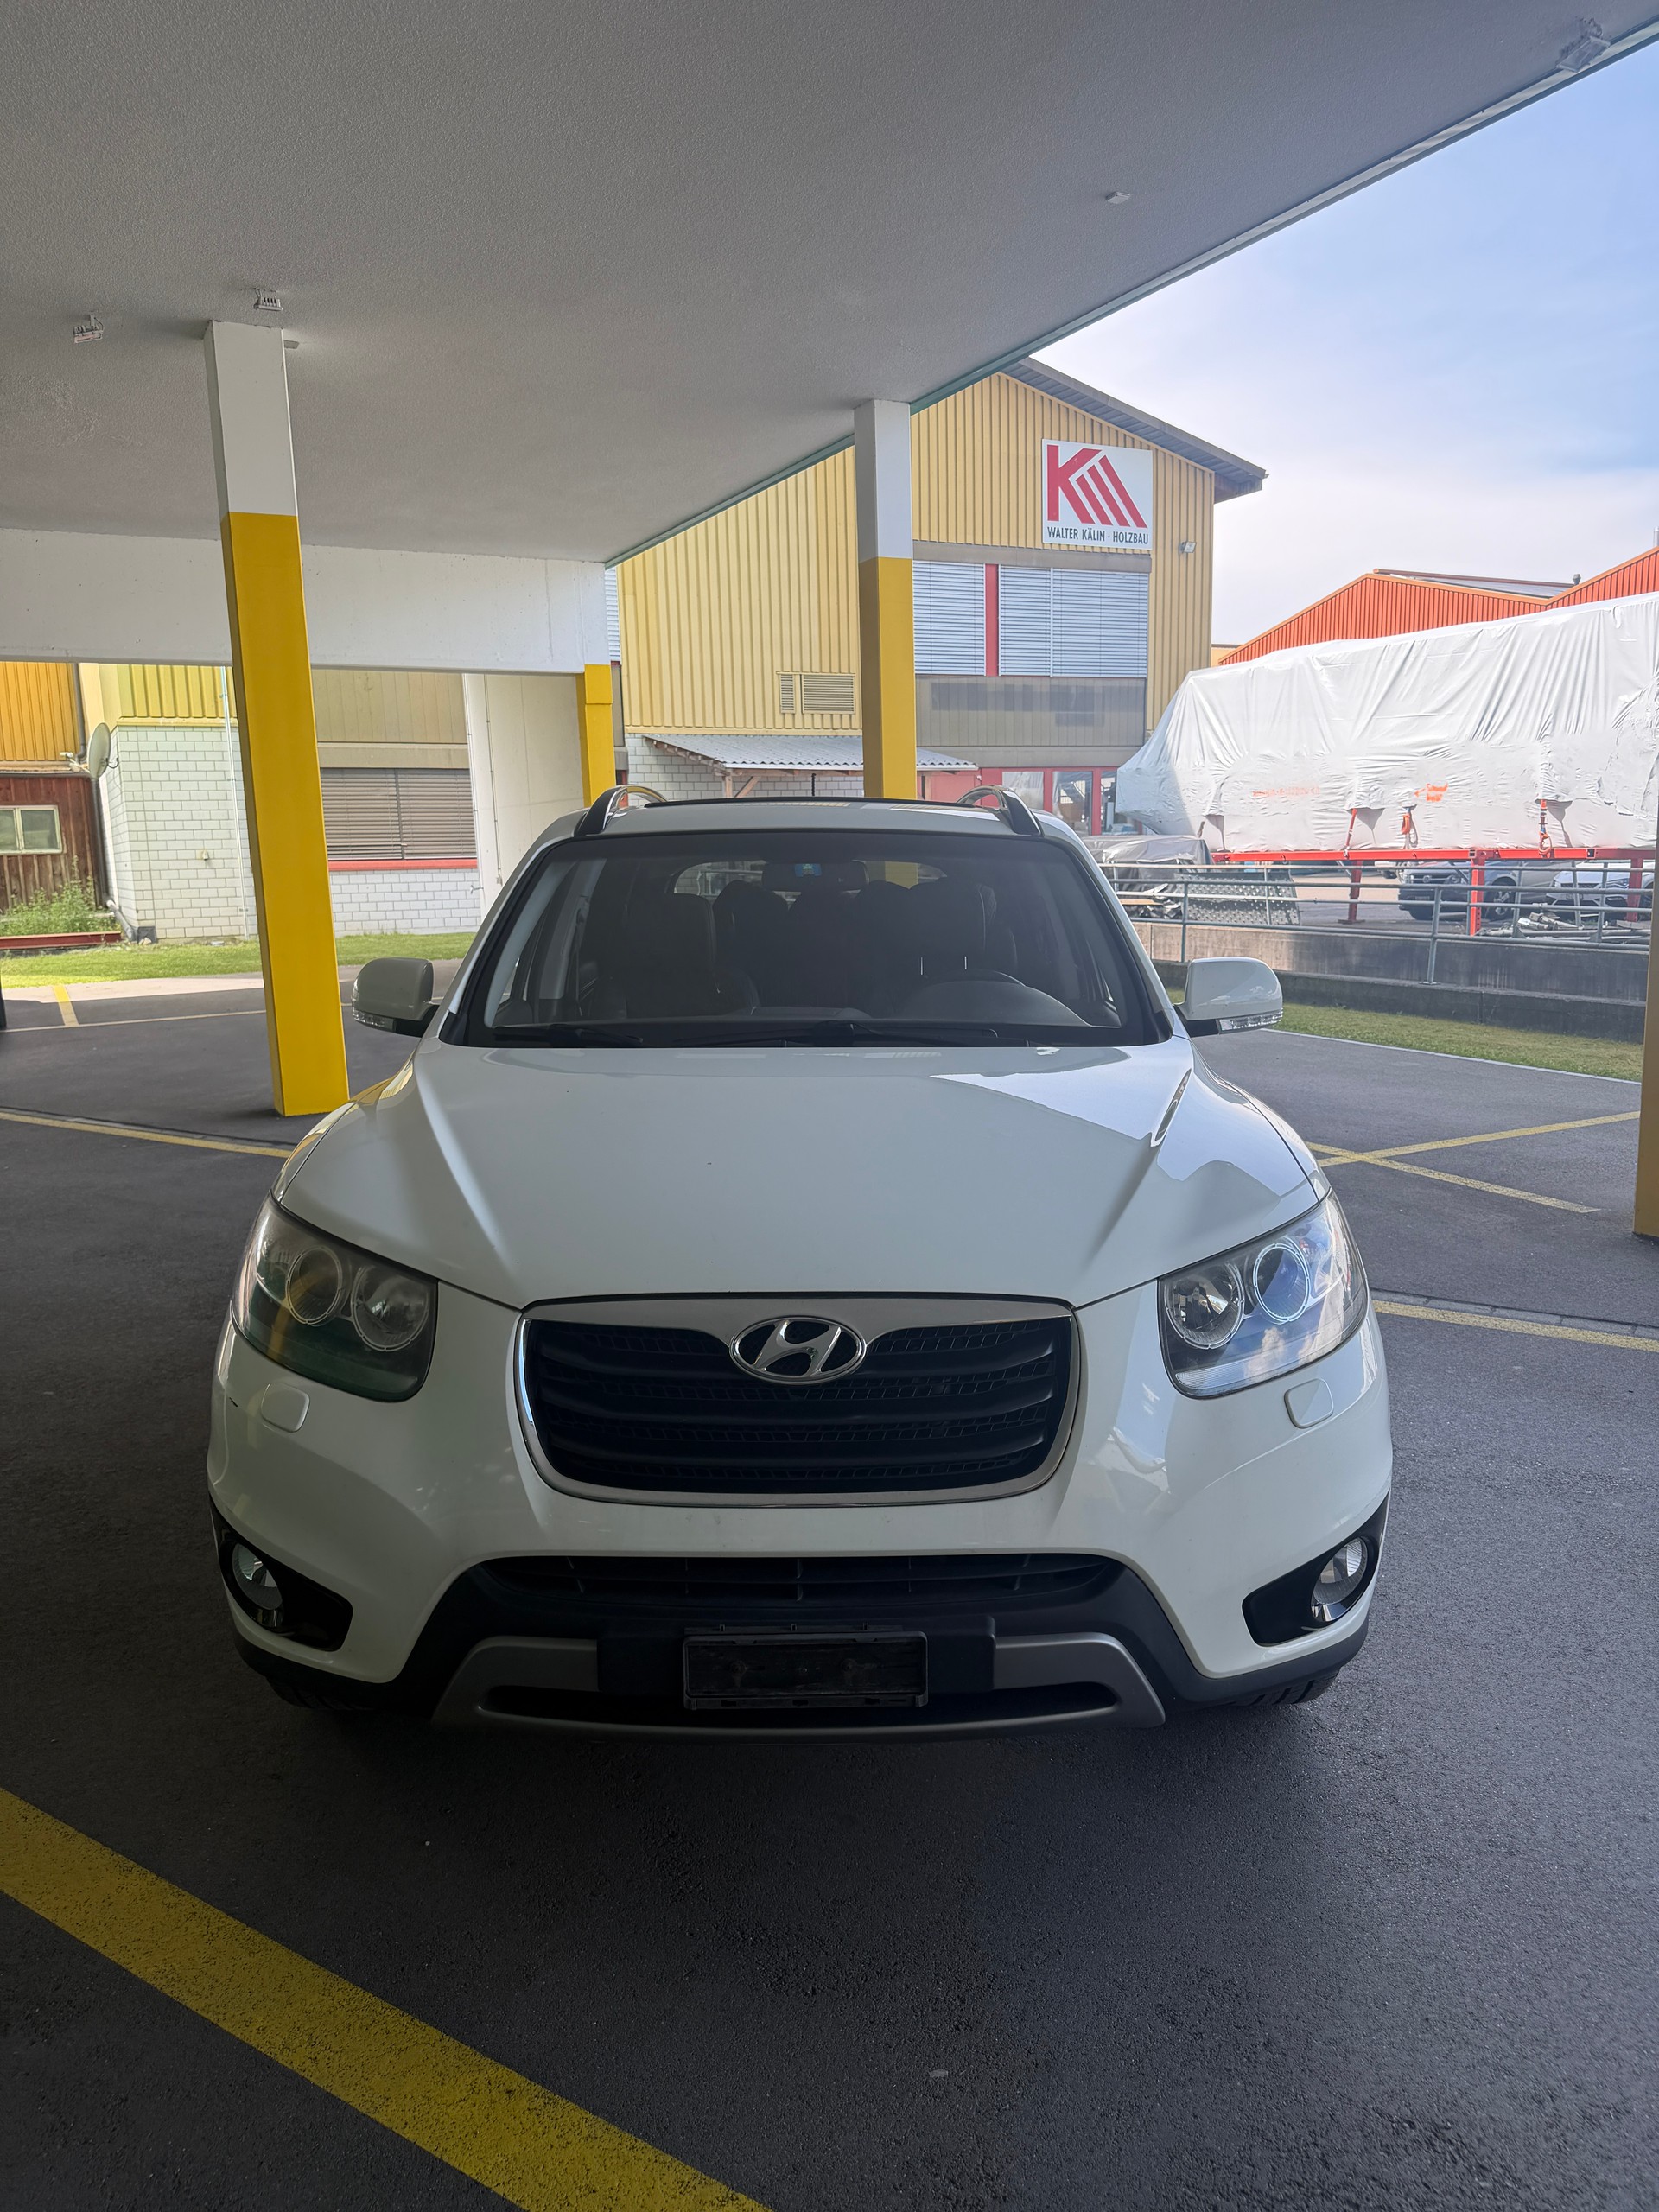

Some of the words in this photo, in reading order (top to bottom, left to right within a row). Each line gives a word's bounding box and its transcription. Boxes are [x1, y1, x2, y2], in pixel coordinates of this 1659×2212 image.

[1047, 526, 1078, 540] WALTER
[1082, 528, 1105, 542] KÄLIN
[1113, 531, 1148, 544] HOLZBAU
